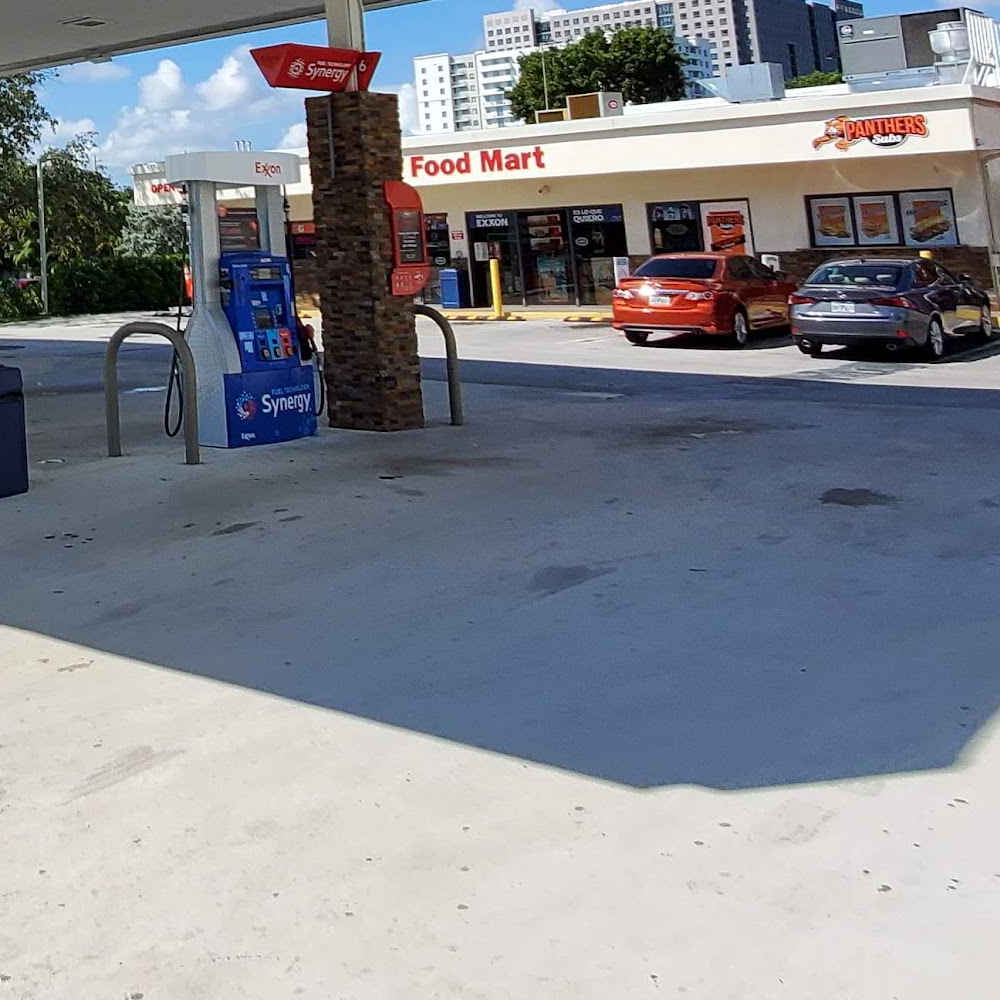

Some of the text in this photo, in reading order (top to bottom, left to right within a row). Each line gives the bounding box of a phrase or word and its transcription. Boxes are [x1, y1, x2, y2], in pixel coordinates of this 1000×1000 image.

[305, 63, 350, 83] Synergy
[358, 60, 367, 73] 6
[845, 115, 927, 142] PANTHERS
[871, 133, 903, 145] Subs
[255, 162, 281, 178] Exxon
[411, 146, 546, 177] Food Mart
[476, 218, 509, 228] EXXON
[261, 393, 311, 418] Synergy
